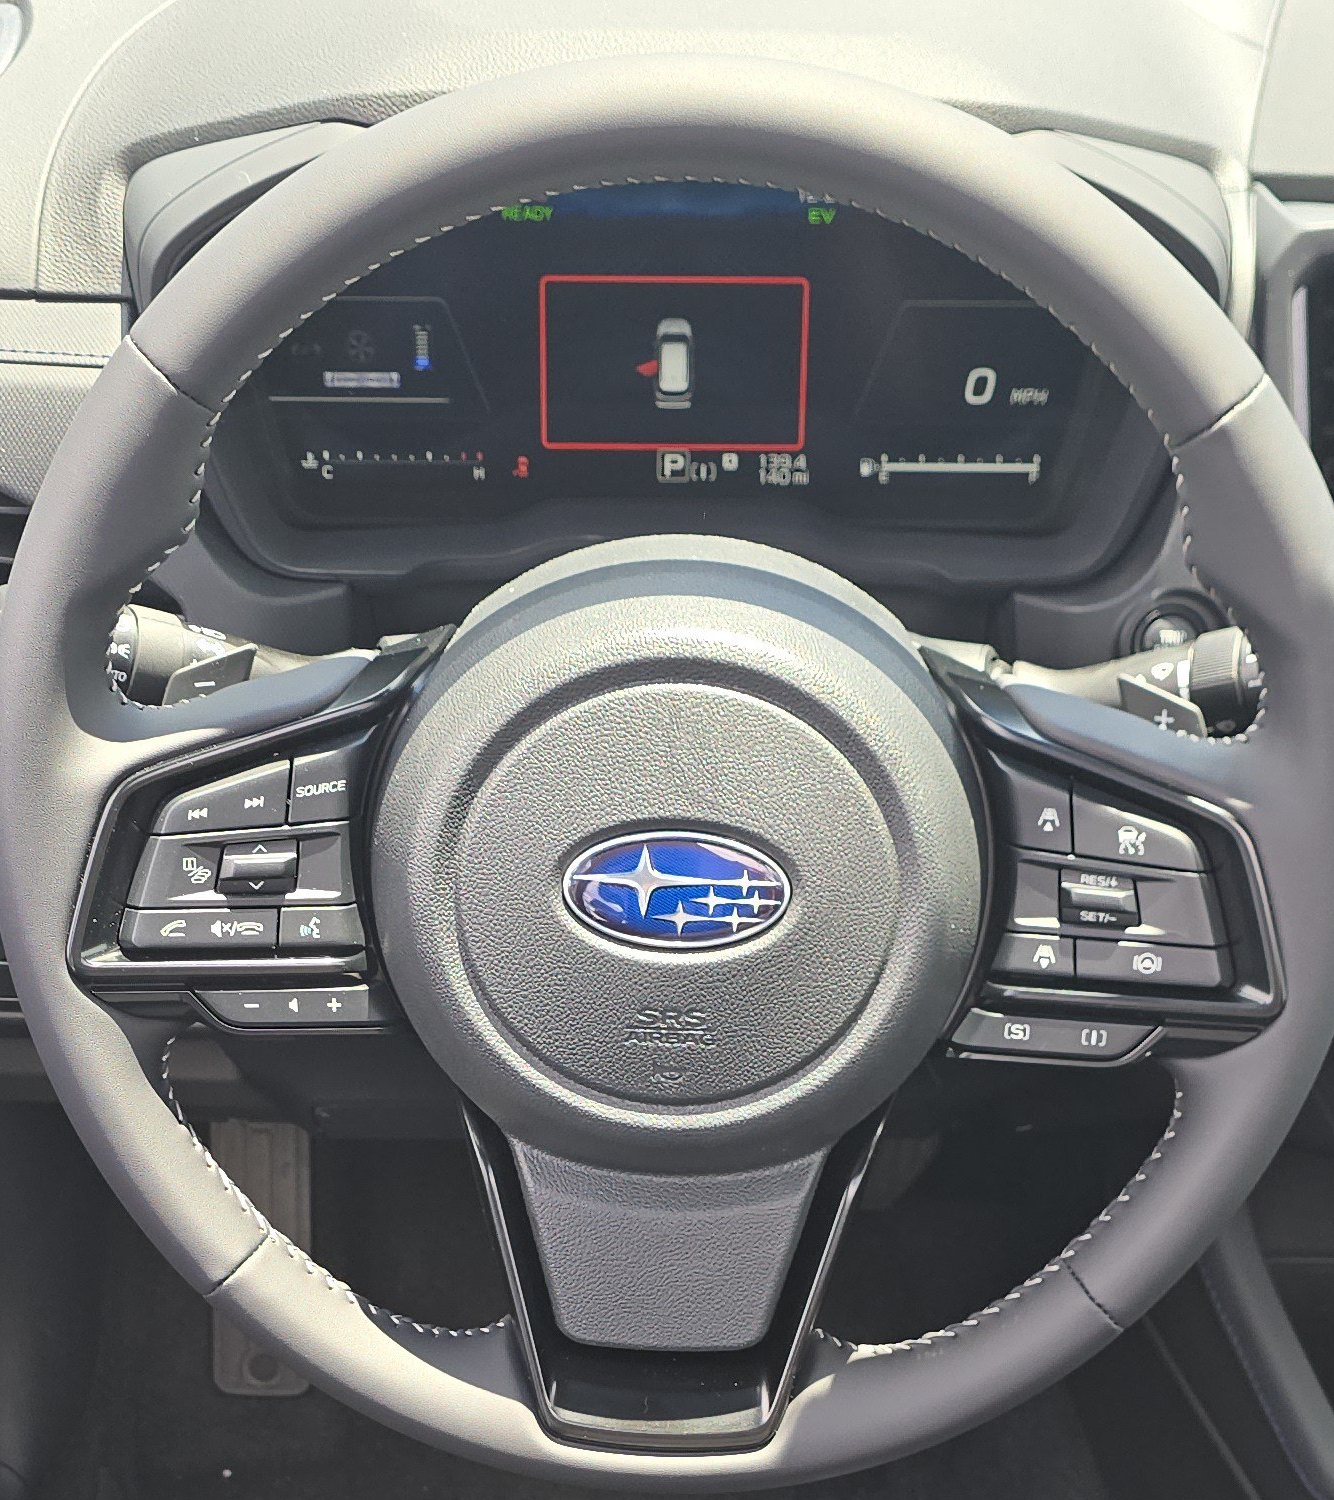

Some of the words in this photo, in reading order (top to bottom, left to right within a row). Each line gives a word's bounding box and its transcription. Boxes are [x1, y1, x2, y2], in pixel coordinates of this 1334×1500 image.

[808, 207, 836, 224] EV
[965, 367, 997, 405] 0
[1010, 387, 1049, 405] MPH
[322, 465, 333, 479] C
[295, 780, 347, 798] SOURCE
[635, 1009, 707, 1029] SRS
